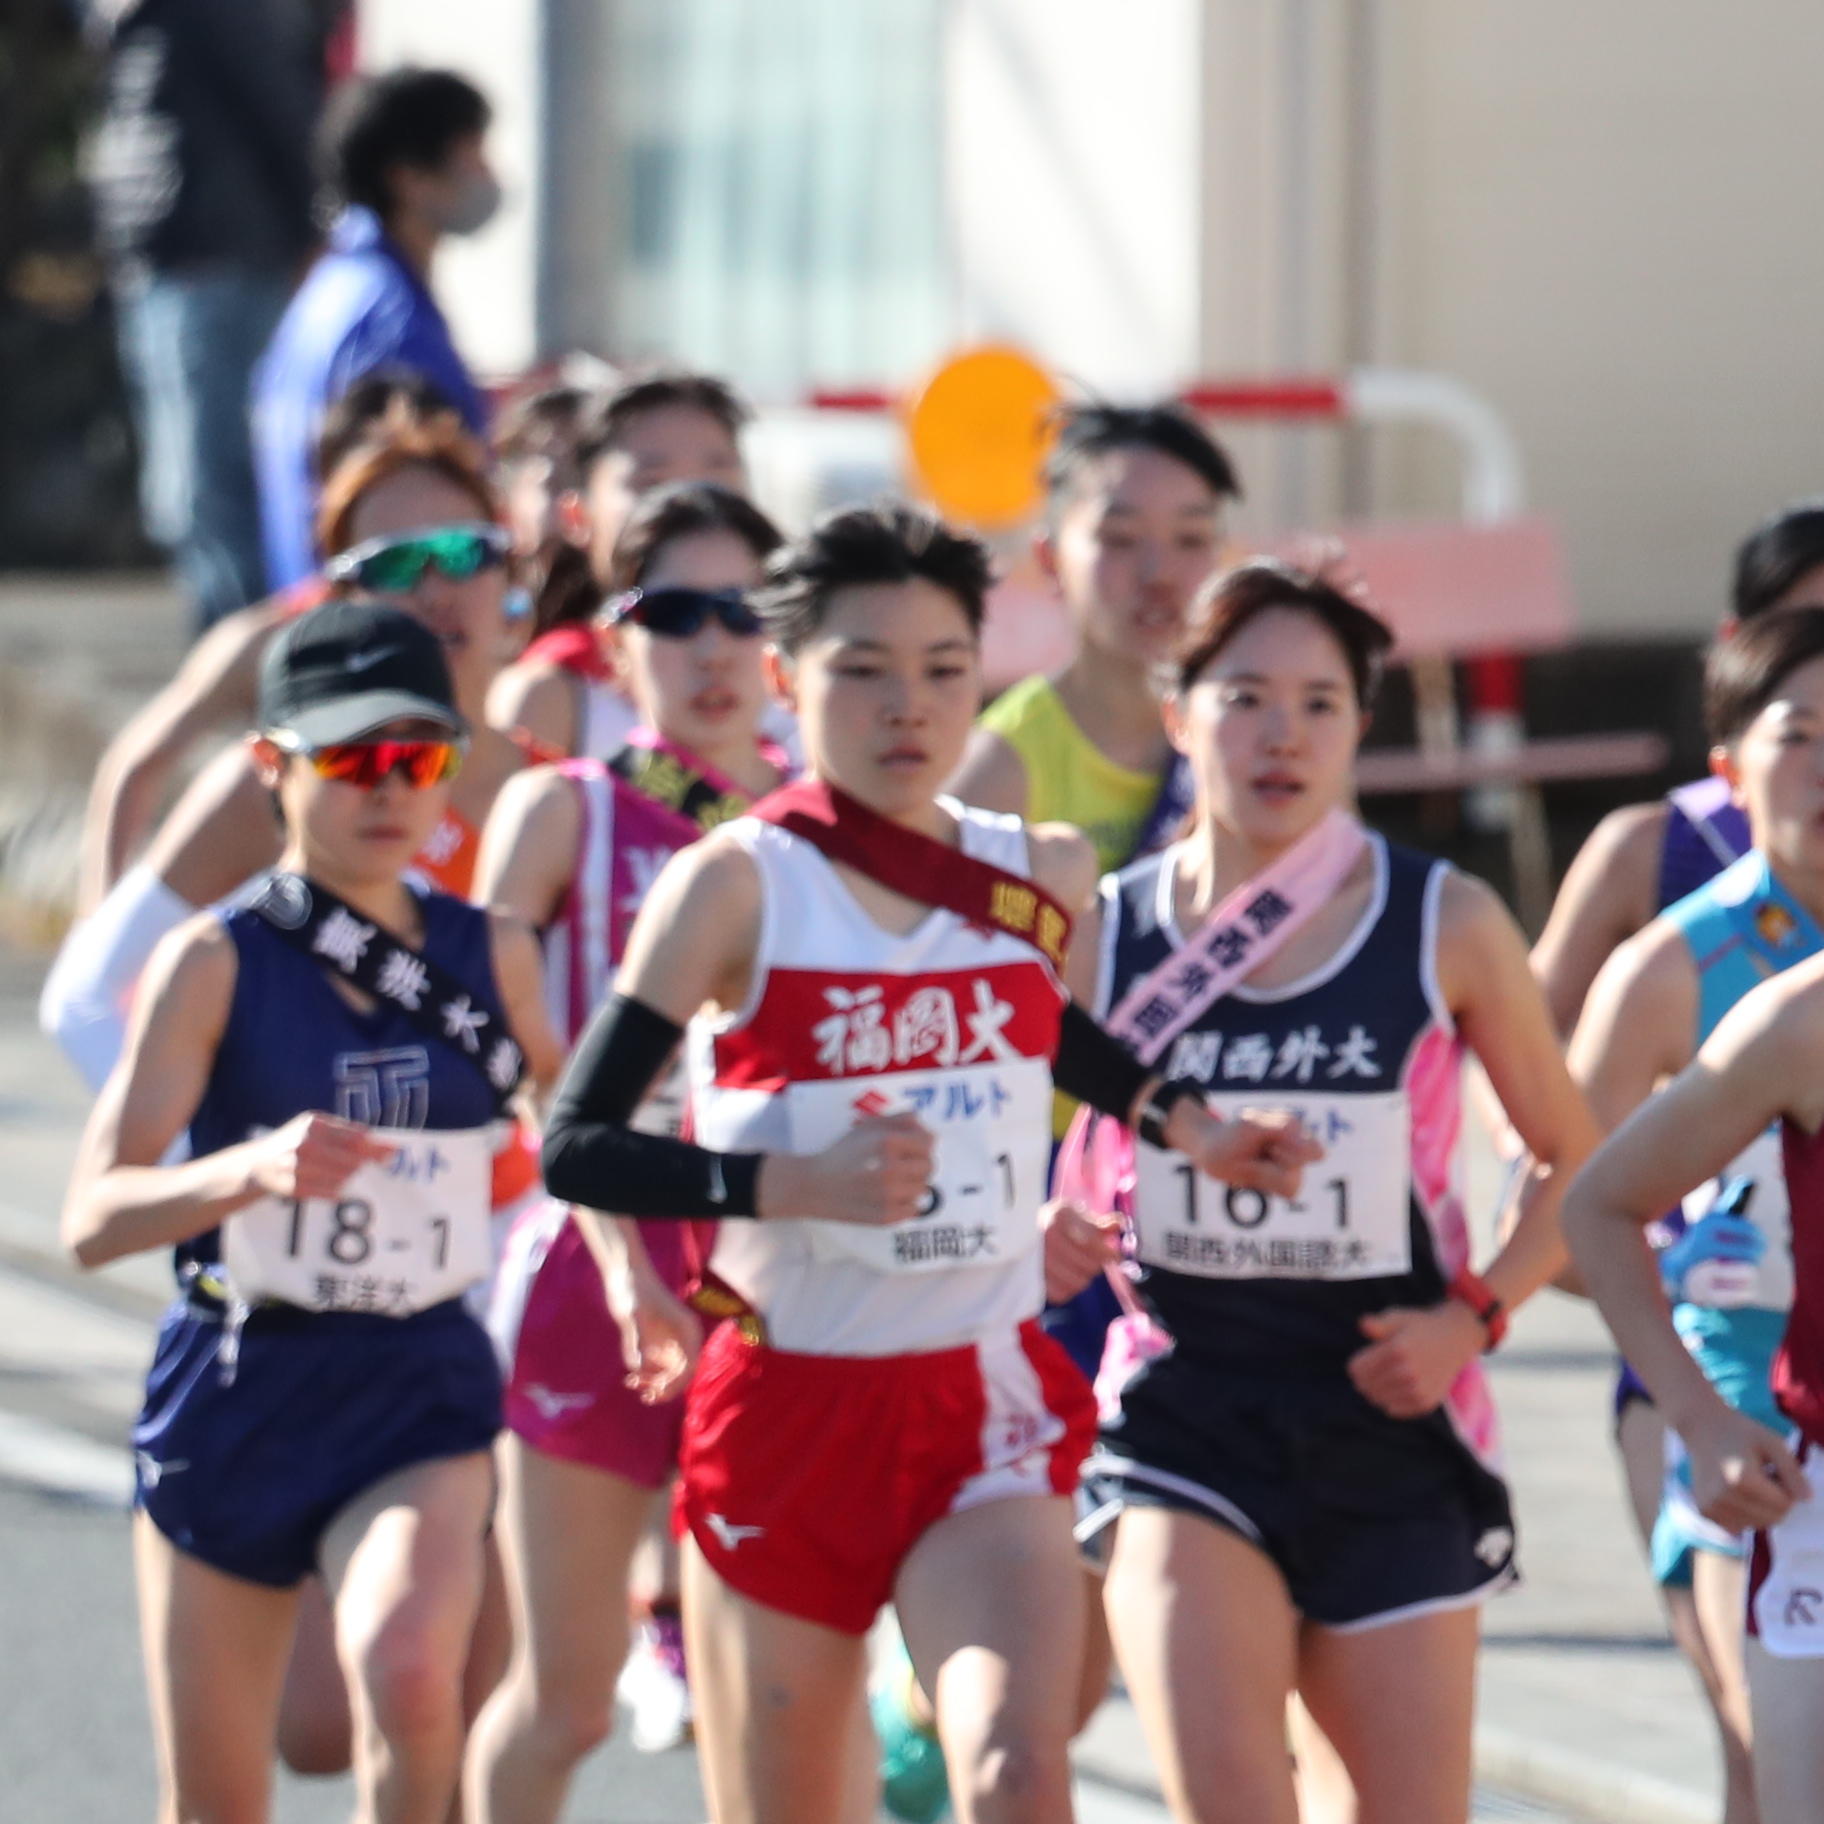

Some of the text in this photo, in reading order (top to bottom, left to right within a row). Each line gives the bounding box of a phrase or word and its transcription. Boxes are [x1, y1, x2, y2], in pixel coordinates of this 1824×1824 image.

[812, 977, 1024, 1075] 福岡大
[1166, 1026, 1382, 1083] 関西外大
[278, 1198, 450, 1270] 18-1
[894, 1223, 997, 1262] 福岡大
[1165, 1233, 1367, 1269] 関西外国語大
